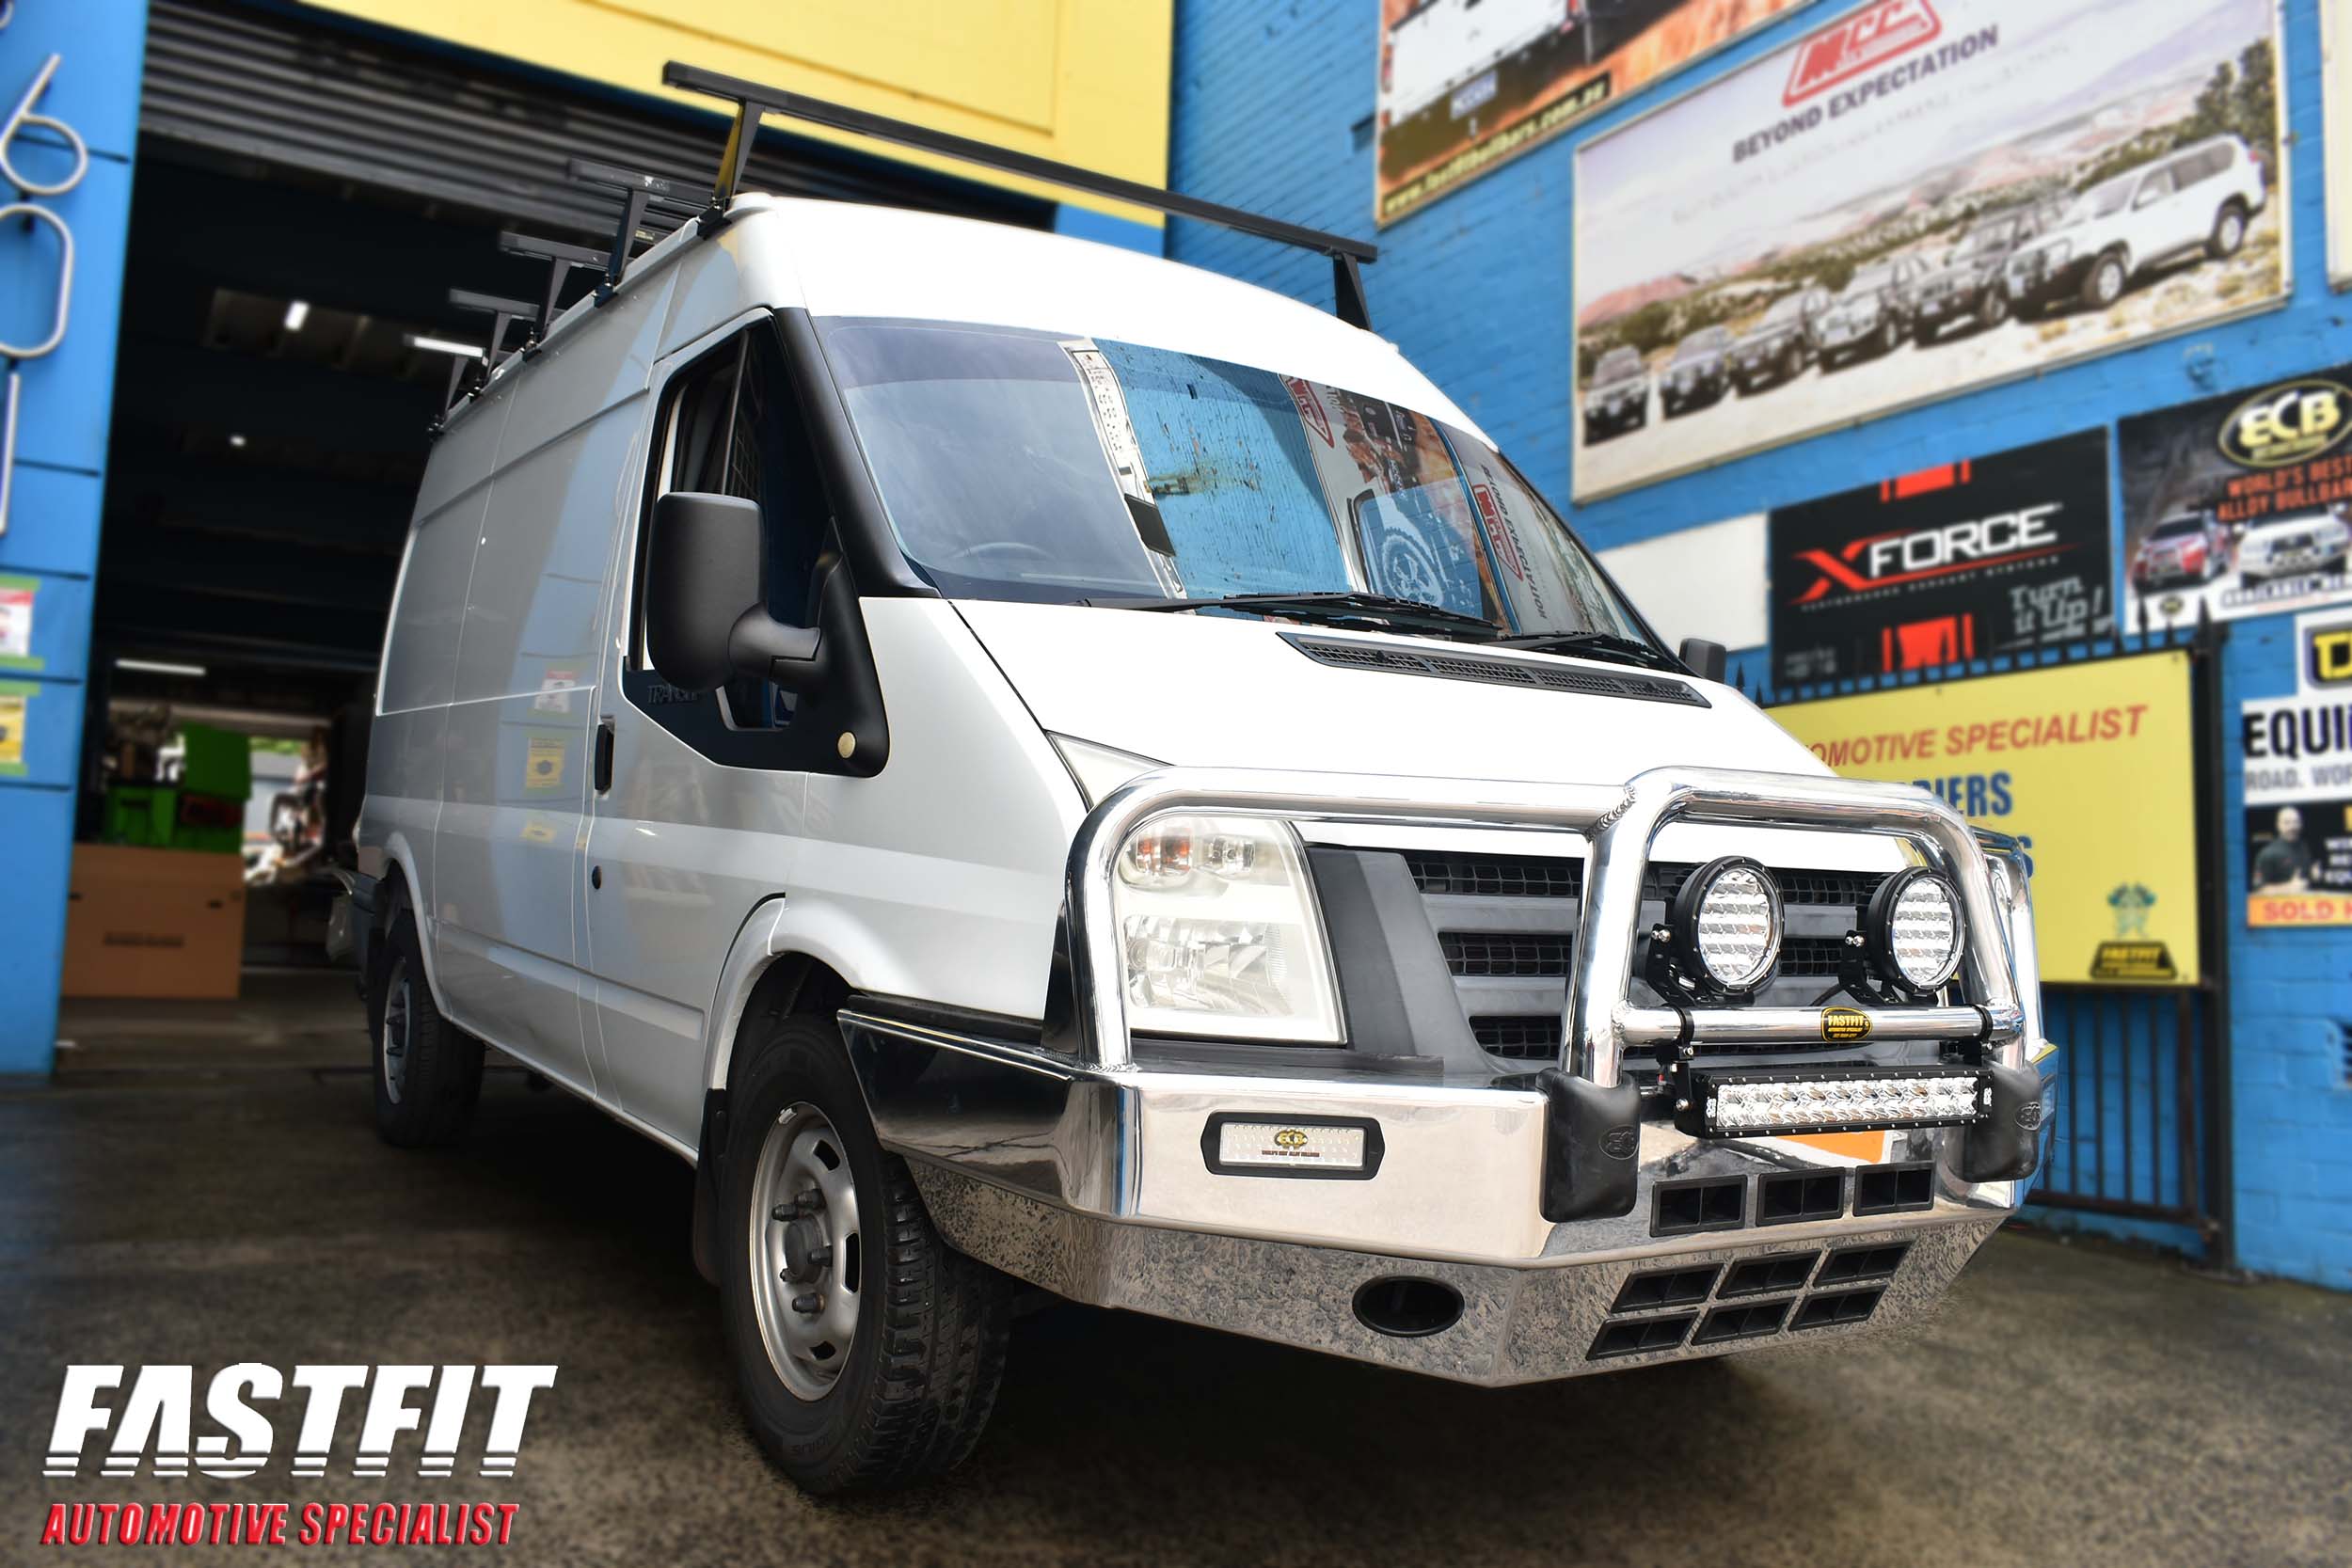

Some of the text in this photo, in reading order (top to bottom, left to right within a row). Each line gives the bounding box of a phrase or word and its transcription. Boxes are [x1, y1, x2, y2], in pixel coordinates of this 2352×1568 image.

[1732, 105, 1823, 165] BEYOND
[1828, 24, 1999, 119] EXPECTATION
[2239, 389, 2342, 449] ECB
[2275, 477, 2352, 511] BULLBAR
[1807, 705, 2149, 768] OMOTIVE SPECIALIST
[2243, 704, 2352, 760] EQUI
[2264, 900, 2334, 923] SOLD
[1827, 1015, 1864, 1026] FASTFIT
